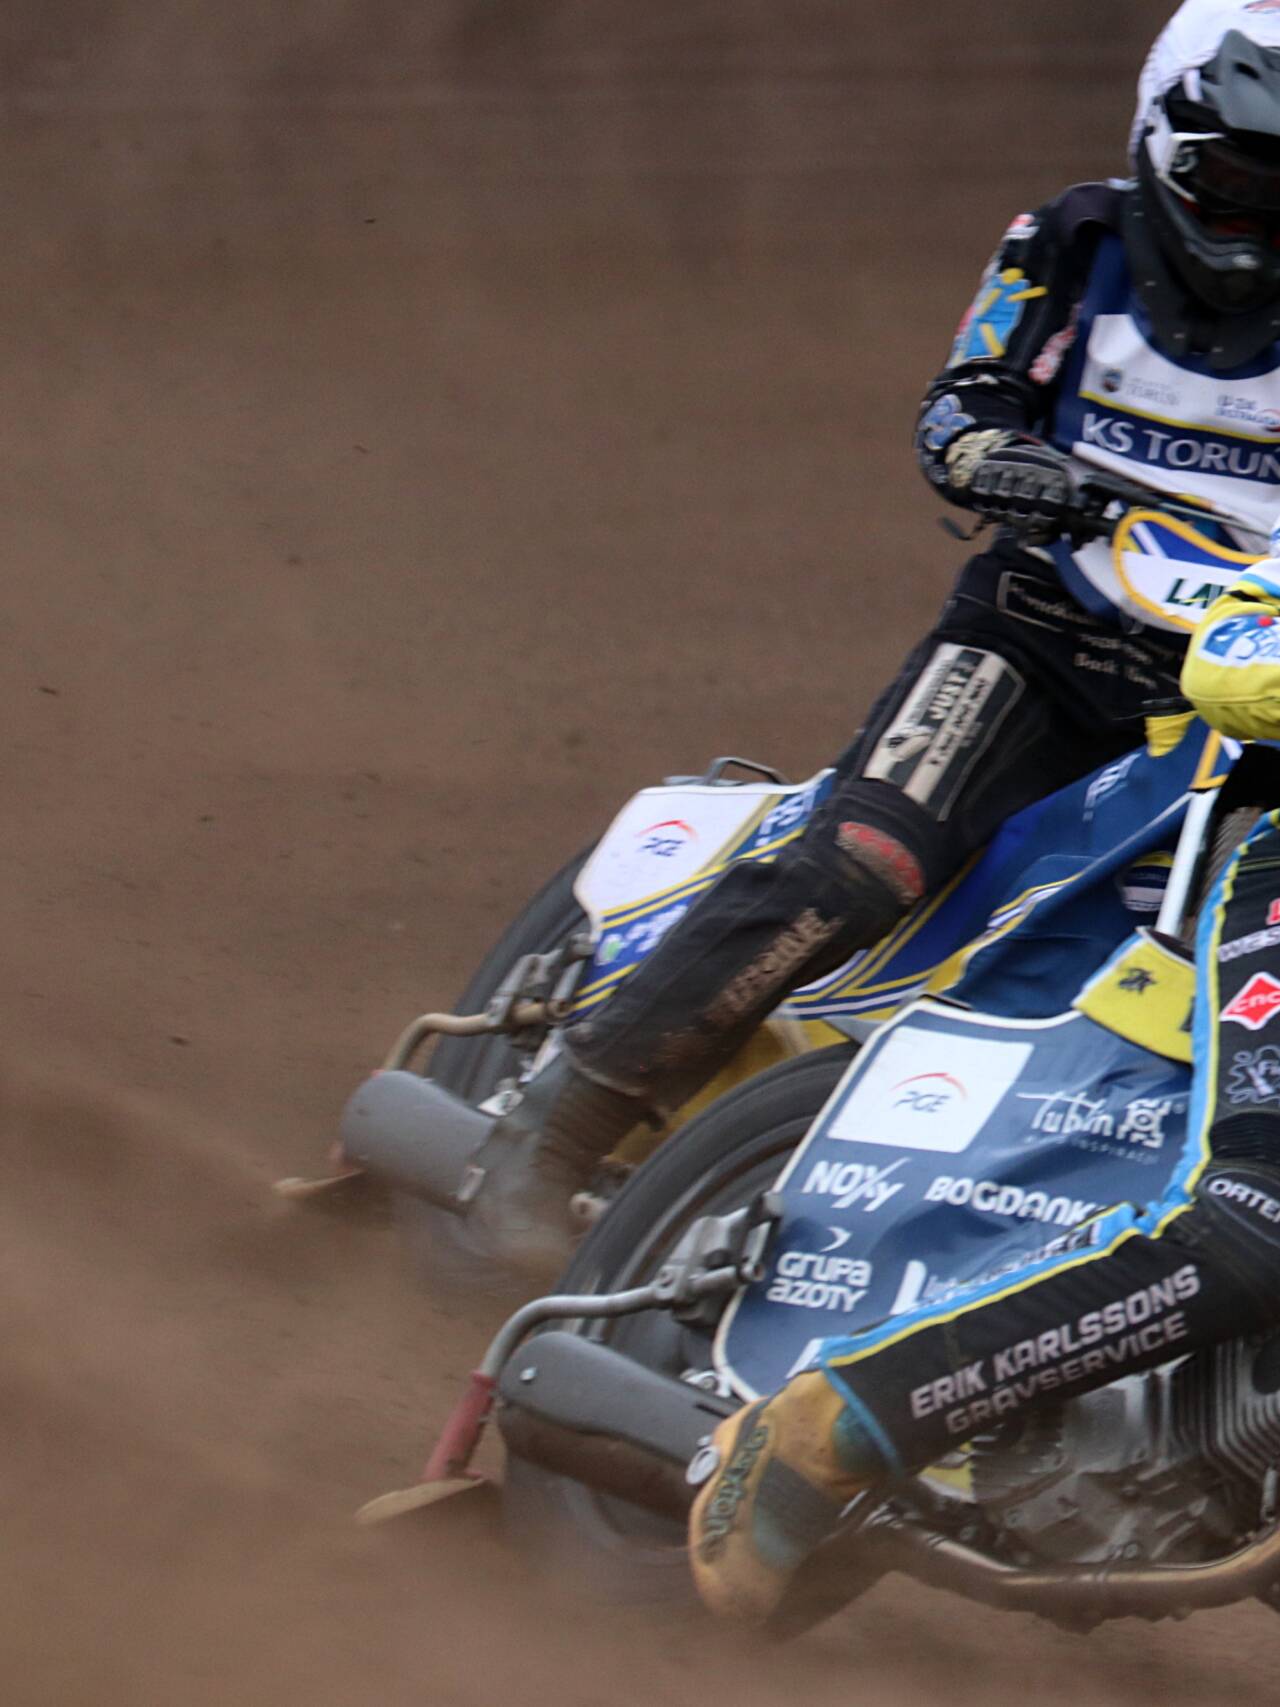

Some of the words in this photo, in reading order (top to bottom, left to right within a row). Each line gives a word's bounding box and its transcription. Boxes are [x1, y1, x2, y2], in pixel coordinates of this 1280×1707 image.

[1082, 412, 1135, 453] KS
[923, 1175, 1107, 1227] BOGDANK
[909, 1359, 988, 1419] ERIK
[992, 1263, 1201, 1382] KARLSSONS
